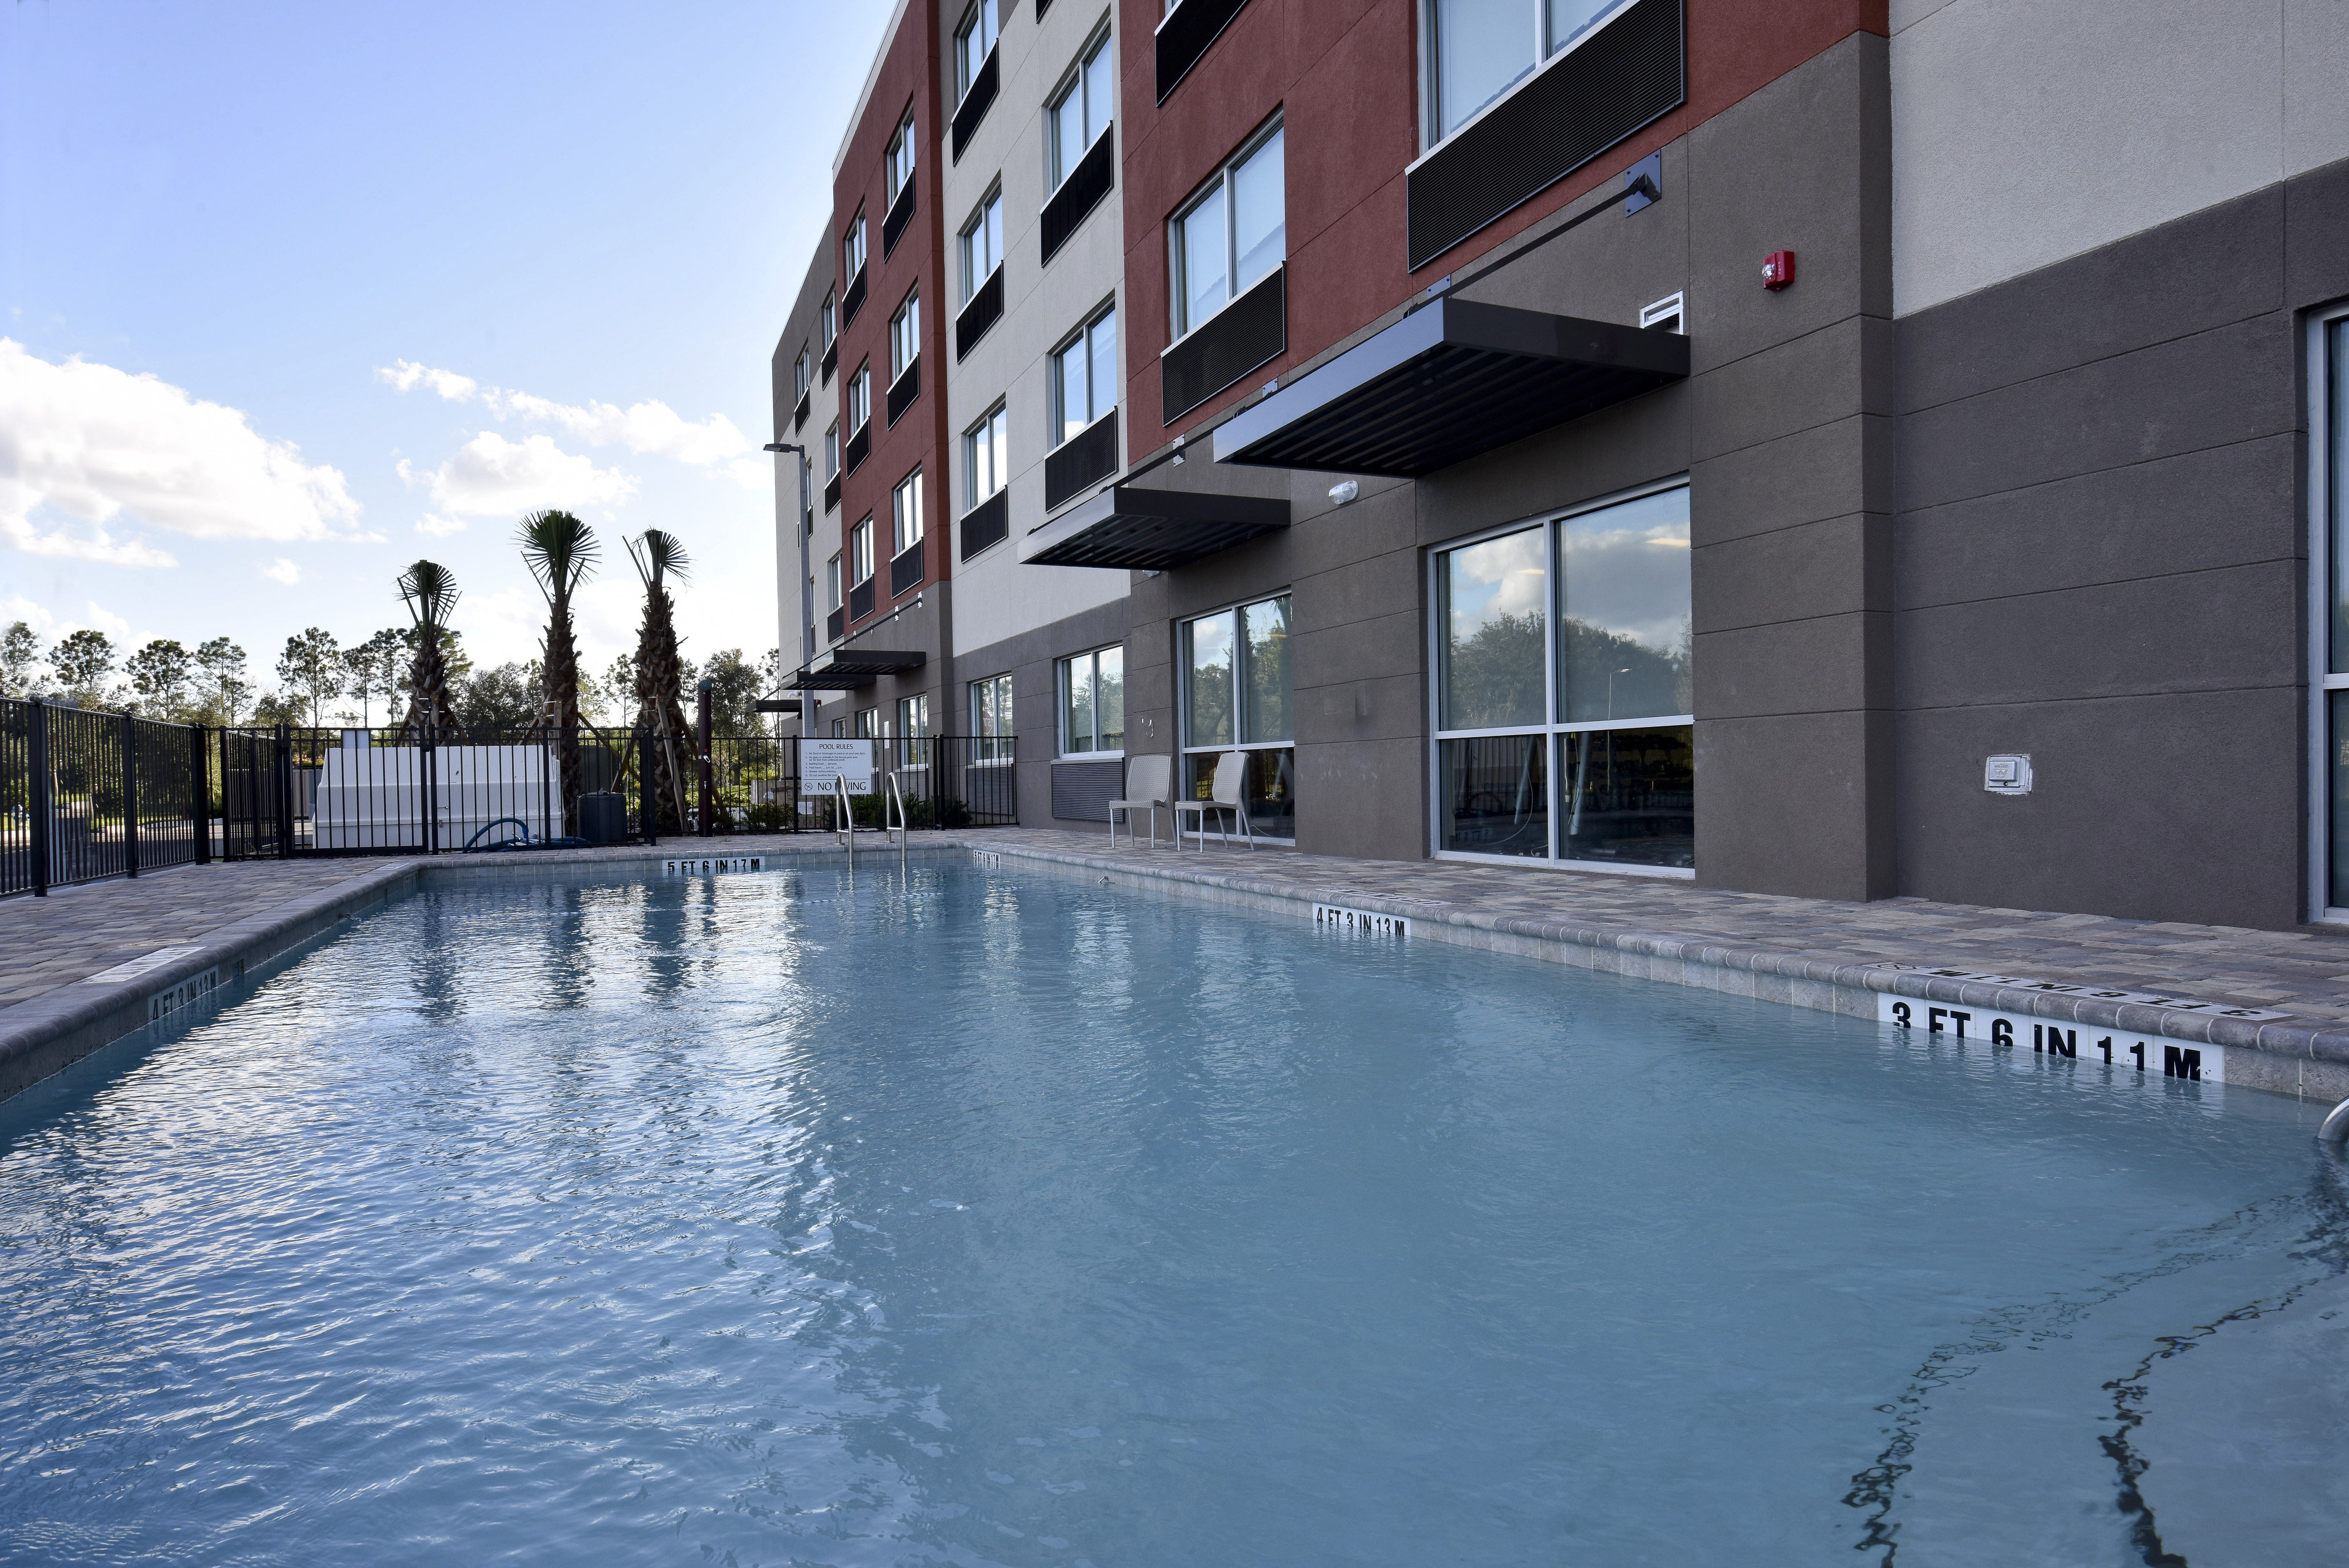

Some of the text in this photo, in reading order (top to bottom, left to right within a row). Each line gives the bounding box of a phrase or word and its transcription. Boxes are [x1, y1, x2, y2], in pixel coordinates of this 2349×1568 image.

[817, 782, 832, 790] NO
[668, 862, 675, 870] 5
[681, 861, 695, 870] FT
[702, 860, 709, 869] 6
[715, 859, 728, 868] IN
[751, 858, 760, 868] M
[1317, 907, 1323, 921] 4
[1328, 909, 1341, 924] FT
[1347, 911, 1354, 927] 3
[1359, 913, 1372, 930] IN
[1394, 919, 1405, 936] M
[152, 999, 159, 1020] 4
[163, 991, 174, 1015] FT
[178, 987, 184, 1007] 3
[187, 980, 197, 1002] IN
[1892, 1001, 1911, 1028] 3
[1929, 1007, 1971, 1038] FT
[1991, 1018, 2013, 1047] 6
[2034, 1024, 2077, 1058] IN
[2164, 1045, 2201, 1082] M
